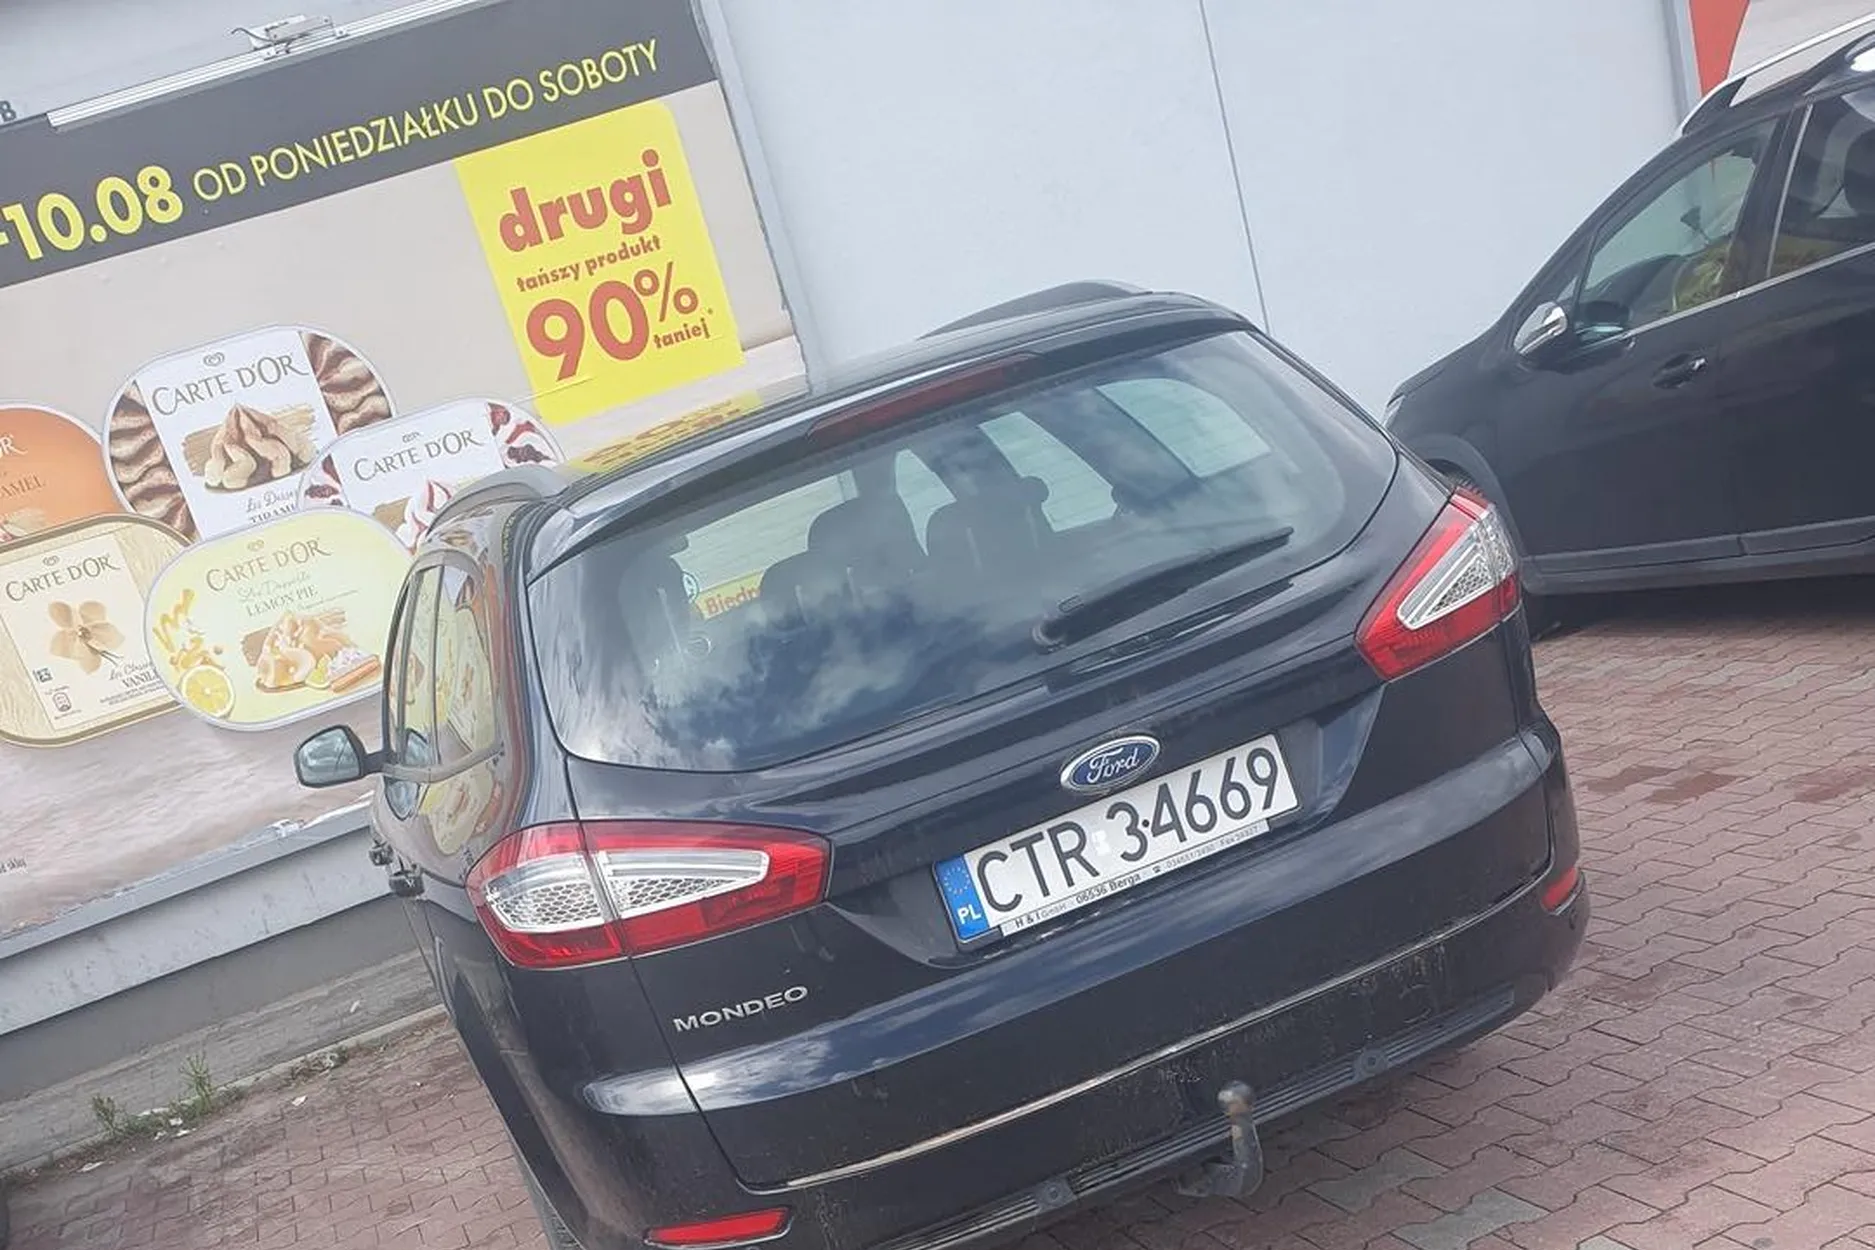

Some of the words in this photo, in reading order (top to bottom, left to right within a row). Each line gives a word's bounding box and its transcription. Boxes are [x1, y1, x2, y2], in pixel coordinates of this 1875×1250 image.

[193, 162, 247, 201] OD
[250, 93, 479, 187] PONIEDZIAŁKU
[483, 78, 534, 119] DO
[539, 38, 657, 102] SOBOTY
[500, 149, 672, 252] drugi
[516, 263, 580, 292] tańszy
[585, 235, 662, 276] produkt
[526, 261, 698, 382] 90%
[152, 373, 232, 416] CARTE
[235, 355, 309, 388] D'OR
[354, 447, 421, 481] CARTE
[425, 430, 484, 458] D'OR
[6, 570, 65, 601] CARTE
[67, 555, 121, 580] D'OR
[206, 556, 270, 592] CARTE
[273, 537, 332, 567] D'OR
[246, 592, 295, 616] LEMON
[296, 584, 318, 601] PIE
[1086, 747, 1140, 783] Ford
[976, 821, 1100, 912] CTR
[1106, 747, 1278, 862] 34669
[957, 904, 982, 925] PL
[1076, 887, 1107, 904] 06536
[1109, 873, 1141, 891] Berga
[673, 986, 808, 1032] MONDEO
